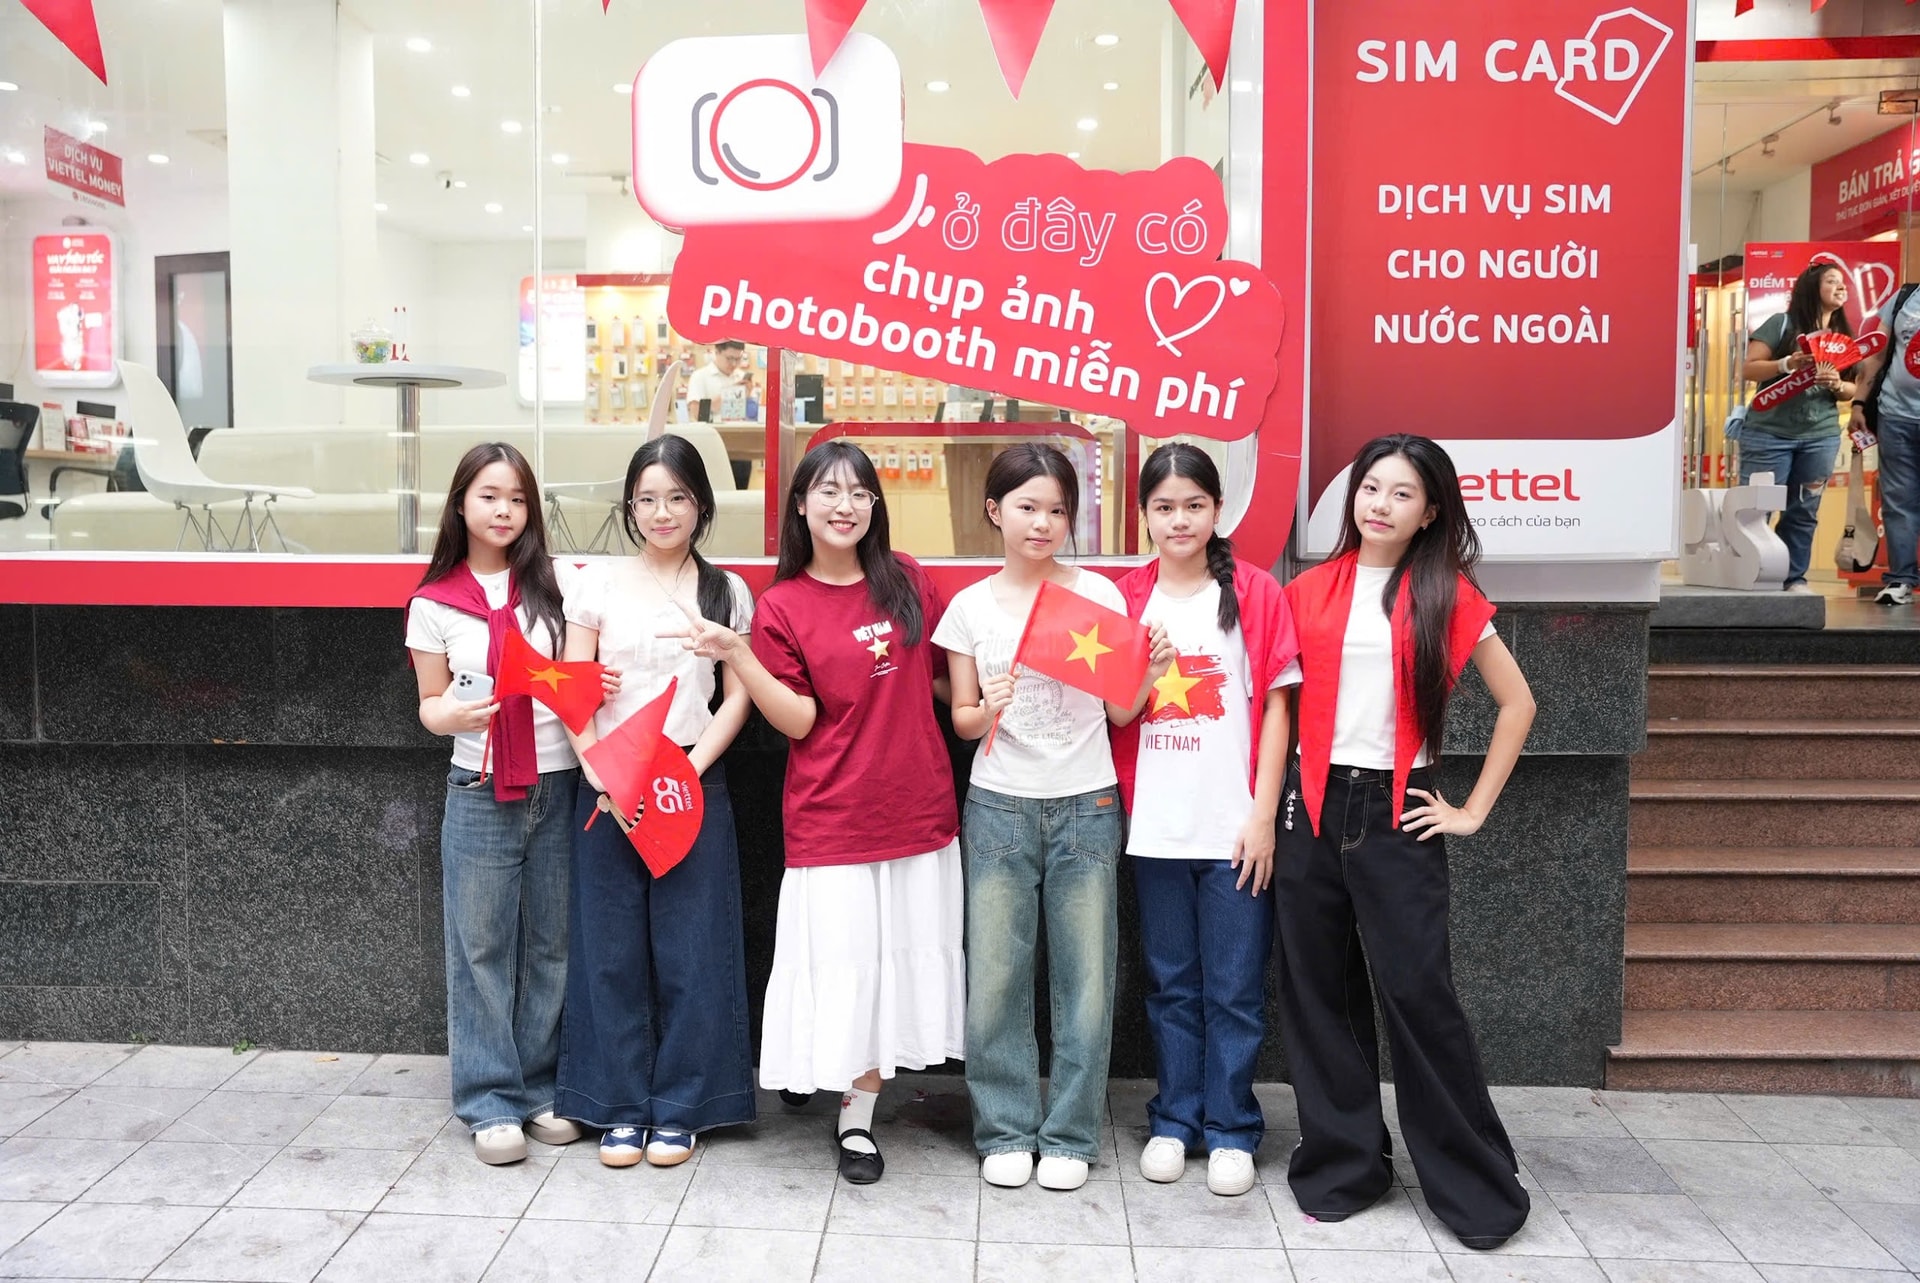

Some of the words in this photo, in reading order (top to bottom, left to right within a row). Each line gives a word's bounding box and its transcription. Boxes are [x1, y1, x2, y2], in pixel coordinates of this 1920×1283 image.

[1356, 39, 1457, 82] SIM
[1485, 38, 1640, 82] CARD
[64, 143, 87, 166] DỊCH
[48, 157, 88, 185] VIETTEL
[88, 173, 122, 198] MONEY
[1838, 169, 1870, 205] BÁN
[1873, 149, 1905, 190] TRẢ
[1378, 184, 1467, 220] DỊCH
[1479, 184, 1531, 220] VỤ
[1544, 184, 1611, 214] SIM
[941, 191, 980, 251] ở
[1001, 195, 1117, 268] đây
[1135, 198, 1208, 255] có
[1387, 249, 1466, 279] CHO
[1479, 240, 1599, 279] NGƯỜI
[863, 253, 985, 320] chụp
[1001, 274, 1095, 335] ảnh
[1374, 305, 1481, 344] NƯỚC
[1493, 305, 1611, 344] NGOÀI
[699, 279, 996, 372] photobooth
[1013, 339, 1140, 401] miễn
[1155, 371, 1246, 420] phí
[1457, 468, 1581, 501] ettel
[1469, 517, 1487, 527] eo
[1490, 515, 1522, 527] cách
[1526, 515, 1551, 527] của
[1554, 515, 1581, 529] bạn
[1145, 734, 1200, 752] VIETNAM
[652, 776, 685, 814] 5G
[681, 780, 693, 811] viettel
